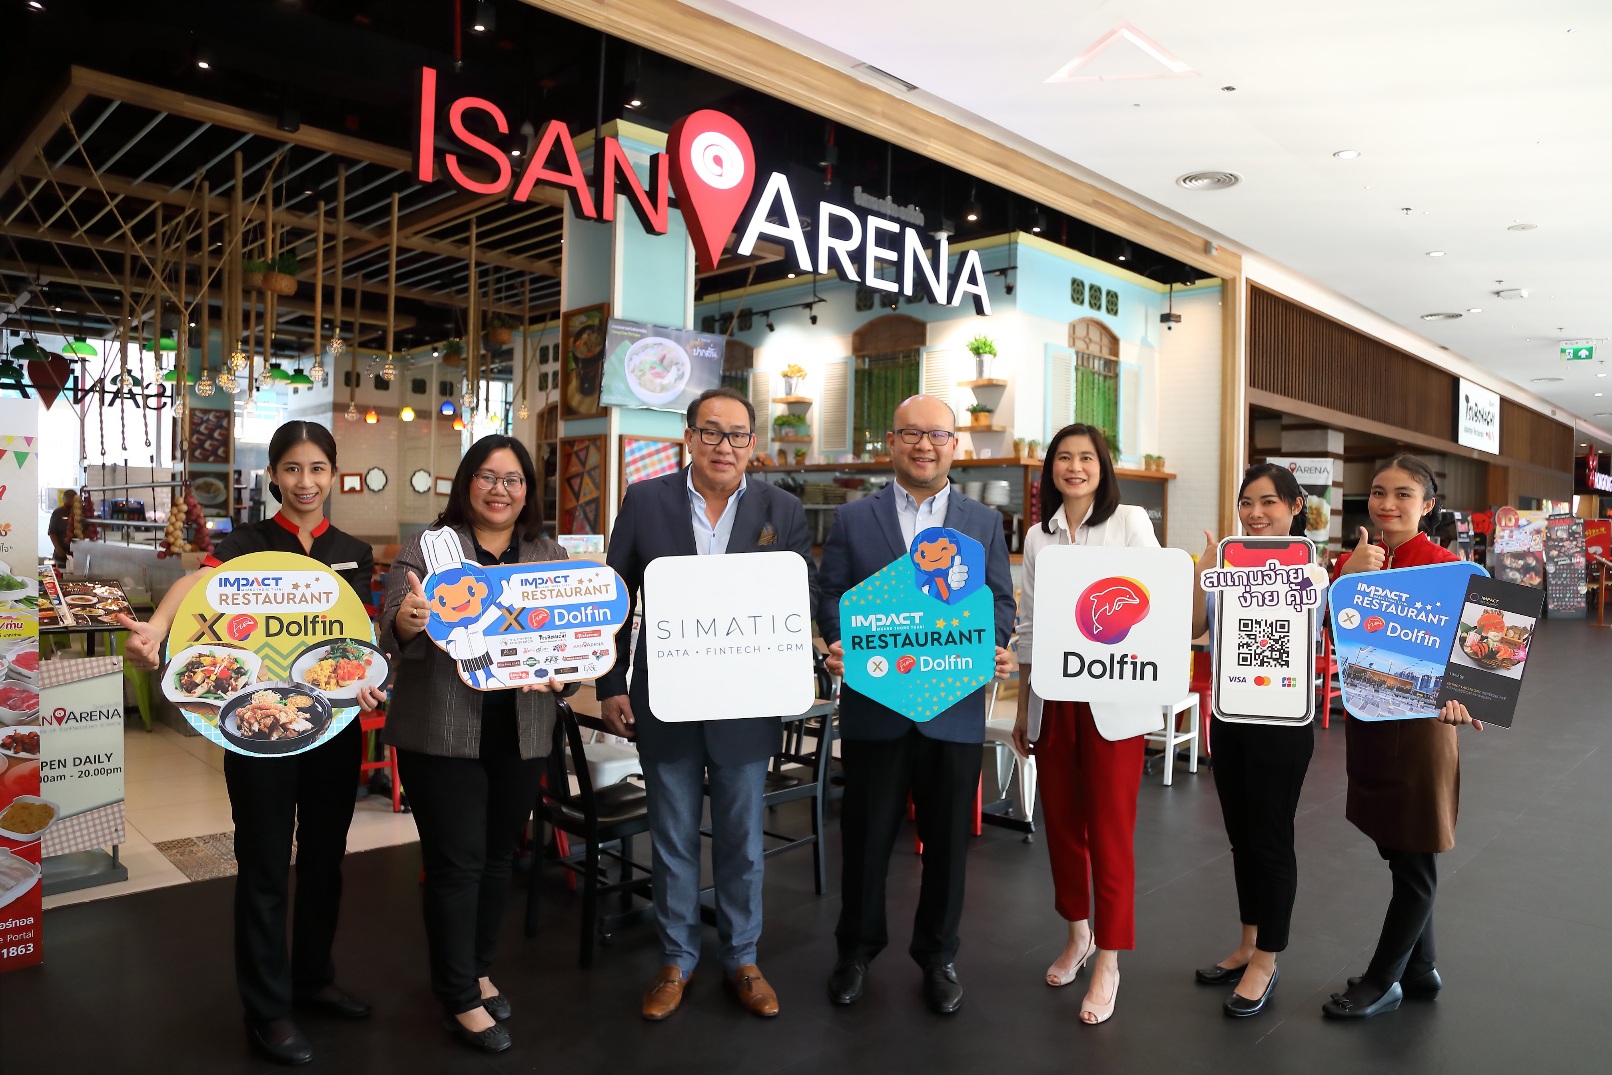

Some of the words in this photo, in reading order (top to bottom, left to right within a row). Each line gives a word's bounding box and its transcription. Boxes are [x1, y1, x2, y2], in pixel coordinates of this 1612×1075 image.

[418, 66, 669, 236] ISAN
[736, 171, 992, 317] ARENA
[1295, 465, 1330, 475] ARENA
[218, 576, 283, 591] IMPACT
[518, 575, 570, 589] IMPACT
[1203, 563, 1304, 588] สแกนจ่าย
[218, 591, 333, 606] RESTAURANT
[521, 583, 611, 602] RESTAURANT
[1238, 586, 1279, 608] ง่าย
[1285, 582, 1317, 612] คุ้ม
[1356, 582, 1410, 602] IMPACT
[553, 605, 611, 625] Dolfin
[1353, 594, 1450, 627] RESTAURANT
[264, 614, 344, 638] Dolfin
[657, 613, 802, 640] SIMATIC
[851, 611, 924, 632] IMPACT
[851, 628, 986, 650] RESTAURANT
[1386, 621, 1440, 649] Dolfin
[657, 649, 690, 658] DATA
[706, 645, 761, 655] FINTECH
[777, 643, 804, 652] CRM
[919, 654, 973, 672] Dolfin
[1062, 651, 1158, 681] Dolfin
[1227, 675, 1247, 683] VISA
[65, 708, 122, 724] ARENA
[40, 758, 67, 772] PEN
[73, 752, 114, 768] DAILY
[77, 766, 122, 779] 20.00pm
[7, 930, 34, 942] Portal
[1, 943, 34, 959] 1863
